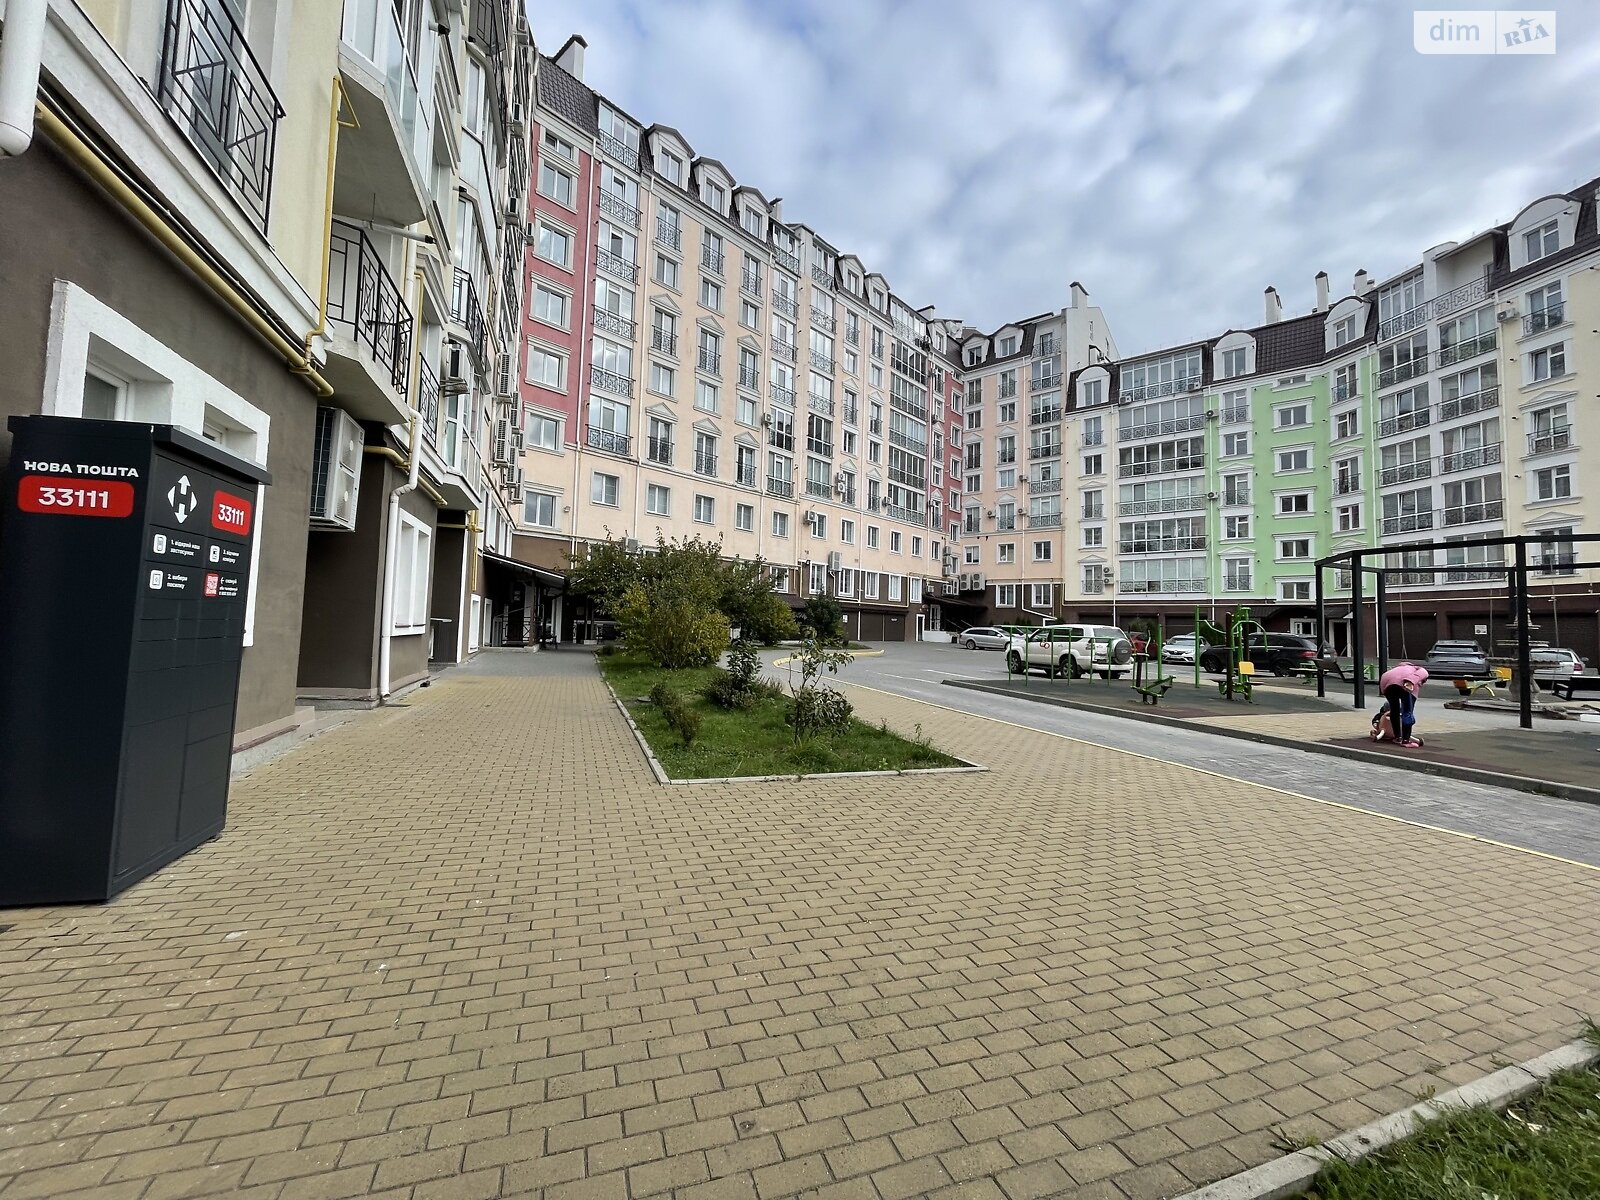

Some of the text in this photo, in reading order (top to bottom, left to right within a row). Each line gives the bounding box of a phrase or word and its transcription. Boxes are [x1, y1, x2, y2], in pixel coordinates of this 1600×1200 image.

[23, 461, 139, 478] НОВА ПОШТА
[38, 486, 109, 509] 33111
[217, 503, 245, 526] 33111
